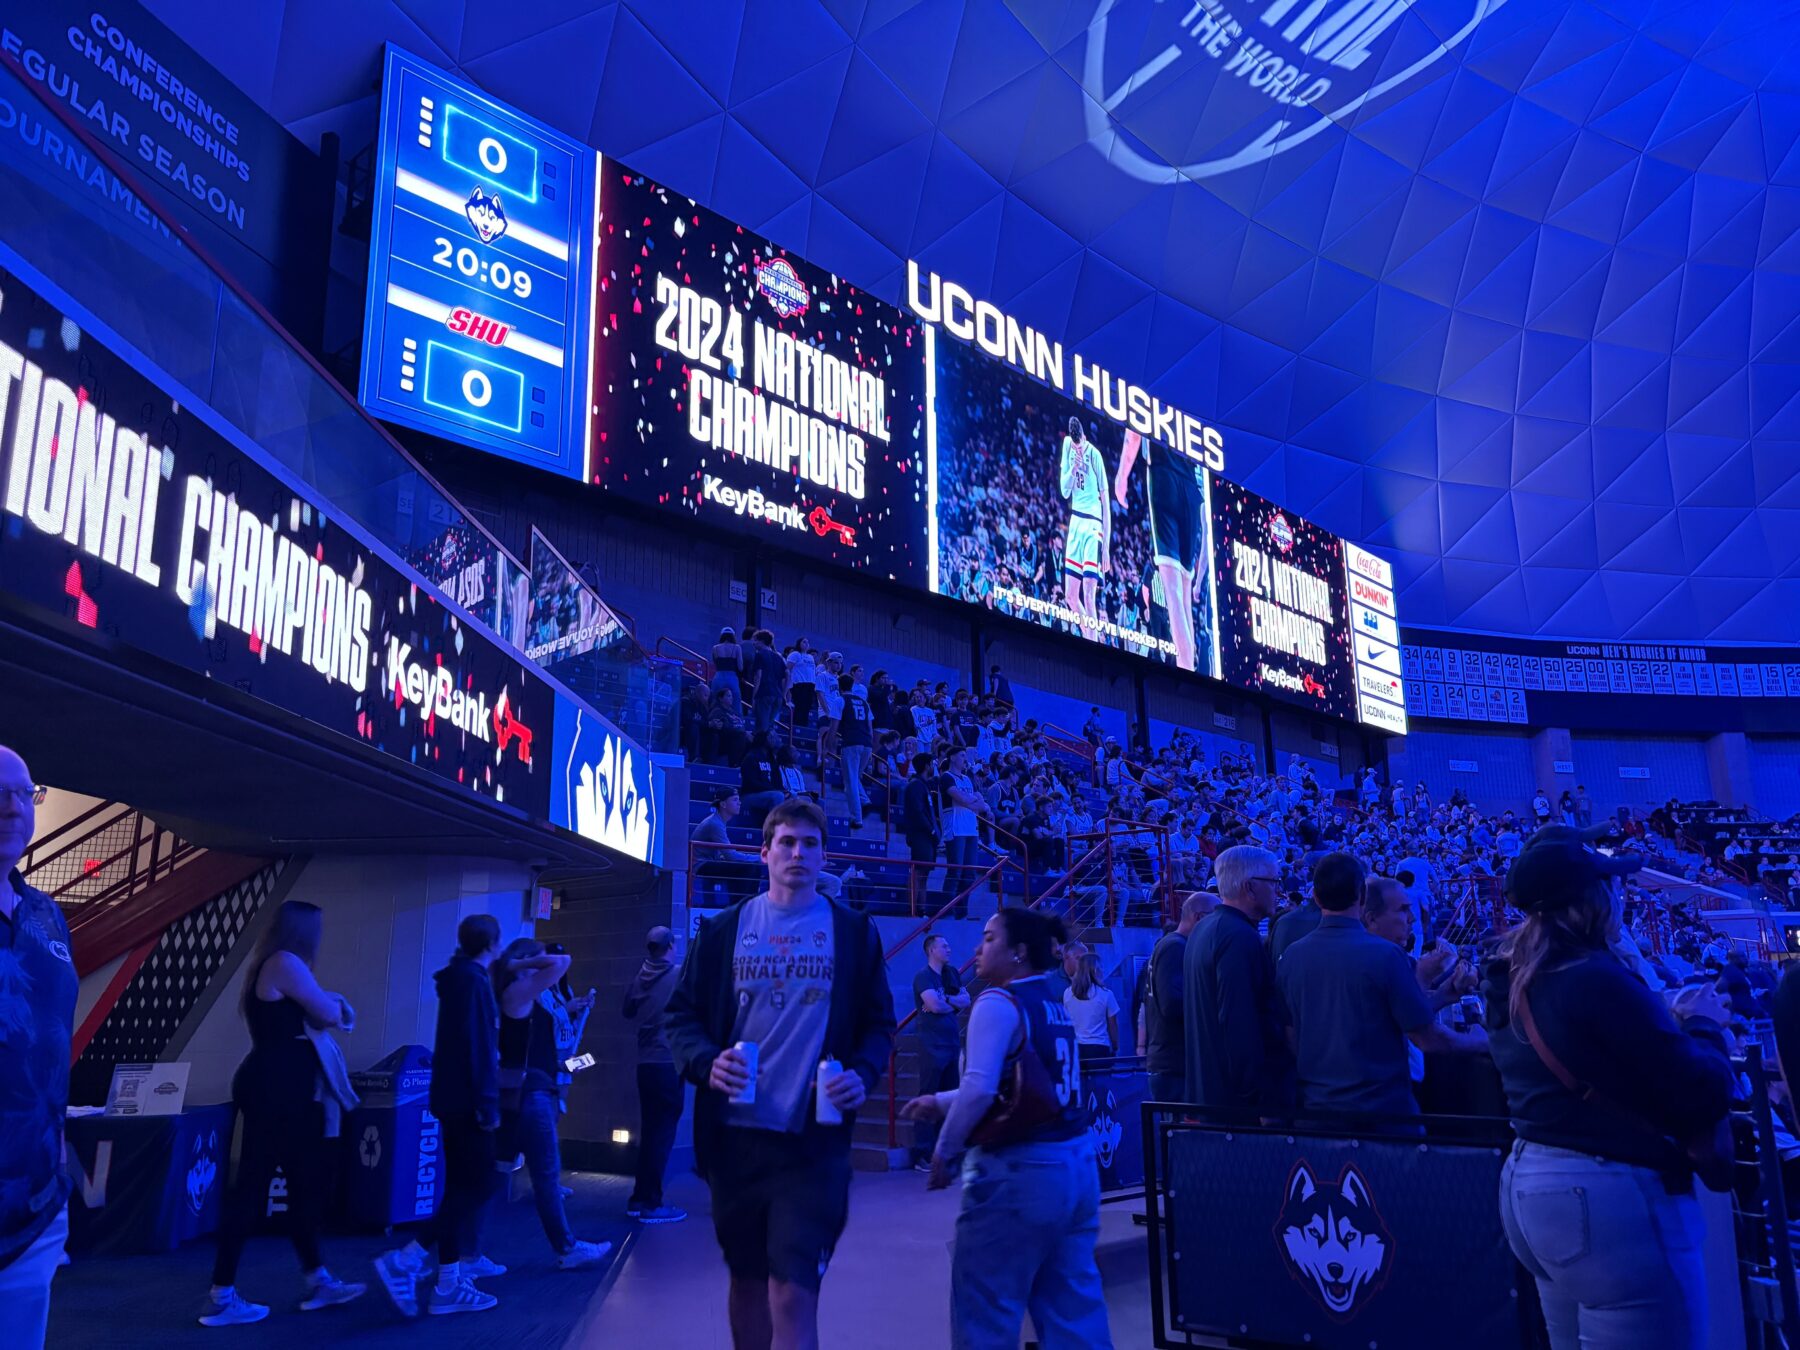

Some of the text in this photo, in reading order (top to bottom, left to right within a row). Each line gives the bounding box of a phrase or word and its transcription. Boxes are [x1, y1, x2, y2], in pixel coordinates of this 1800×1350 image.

[90, 12, 239, 146] CONFERENCE
[1223, 36, 1332, 107] WORLD
[67, 26, 250, 182] CHAMPIONSHIPS
[478, 137, 508, 174] 0
[137, 134, 245, 230] SEASON
[432, 236, 532, 299] 20:09
[447, 305, 510, 347] SHU
[655, 273, 890, 442] 2024 NATIONAL
[907, 259, 1225, 472] UCONN HUSKIES
[461, 368, 492, 408] 0
[688, 367, 866, 500] CHAMPIONS
[703, 473, 806, 531] KeyBank
[1233, 539, 1333, 625] 2024 NATIONAL
[1355, 580, 1389, 609] DUNKIN'
[175, 474, 371, 693] CHAMPIONS
[387, 635, 490, 742] KeyBank
[1015, 593, 1081, 625] EVERYTHING
[1081, 613, 1119, 638] YOU'VE
[1119, 628, 1158, 649] WORKED
[1250, 596, 1327, 666] CHAMPIONS
[1403, 647, 1419, 660] 34
[1424, 649, 1440, 662] 44
[1464, 653, 1479, 665] 32
[1485, 655, 1499, 667] 42
[1505, 657, 1519, 669] 42
[1566, 645, 1600, 656] UCONN
[1630, 646, 1665, 660] HUSKIES
[1524, 658, 1539, 670] 42
[1544, 661, 1560, 672] 50
[1566, 661, 1583, 673] 25
[1612, 663, 1624, 674] 13
[1653, 664, 1669, 676] 22
[1766, 666, 1779, 678] 15
[1261, 663, 1305, 692] KeyBank
[1362, 676, 1393, 697] TRAVELERS
[1431, 685, 1440, 697] 3
[1448, 686, 1463, 699] 24
[1511, 691, 1520, 703] 2
[1363, 703, 1386, 720] UCONN
[764, 955, 795, 965] NCAA
[732, 964, 832, 981] FINAL FOUR
